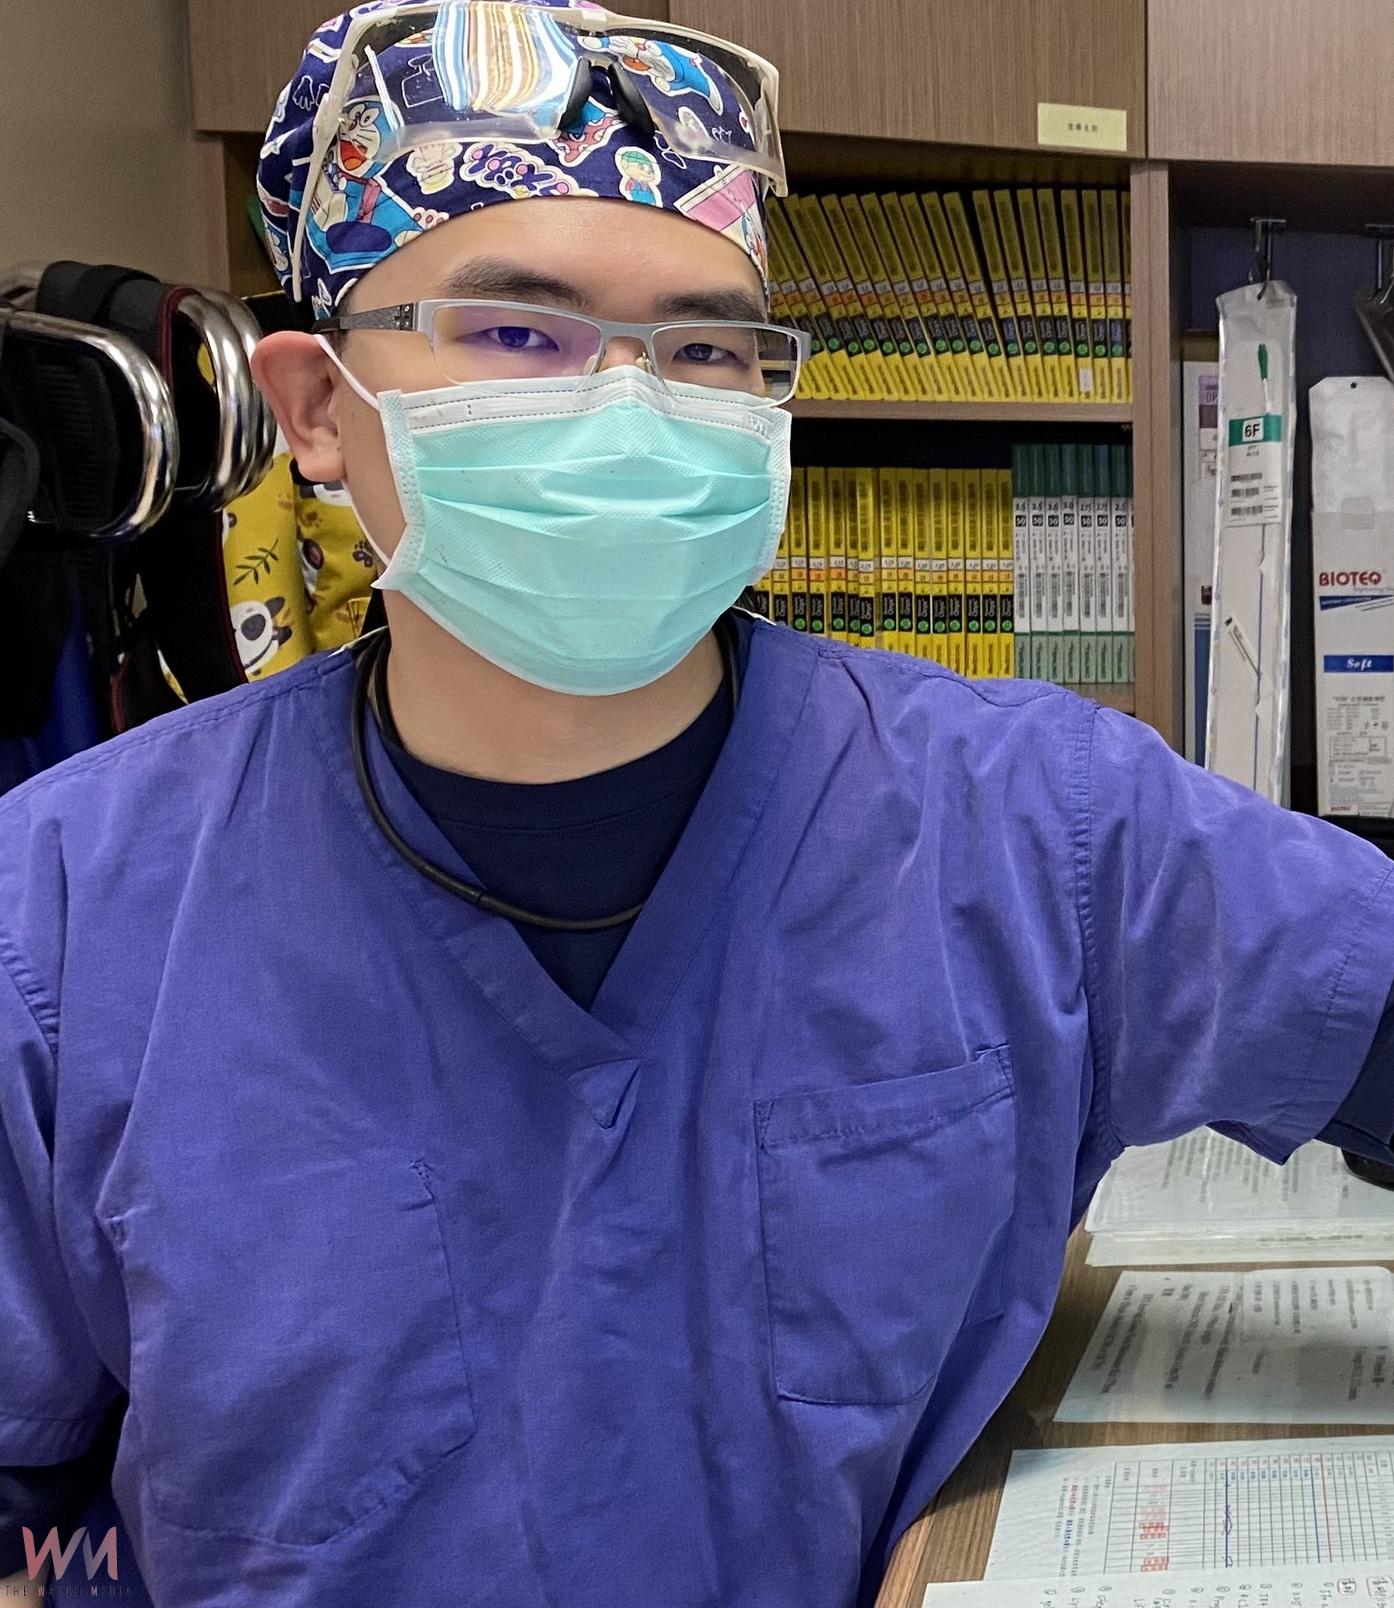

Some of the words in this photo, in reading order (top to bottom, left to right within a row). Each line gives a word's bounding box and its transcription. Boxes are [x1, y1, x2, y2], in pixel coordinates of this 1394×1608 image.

[1245, 424, 1260, 437] 6F
[1319, 571, 1382, 586] BIOTEQ
[1346, 658, 1373, 670] Soft
